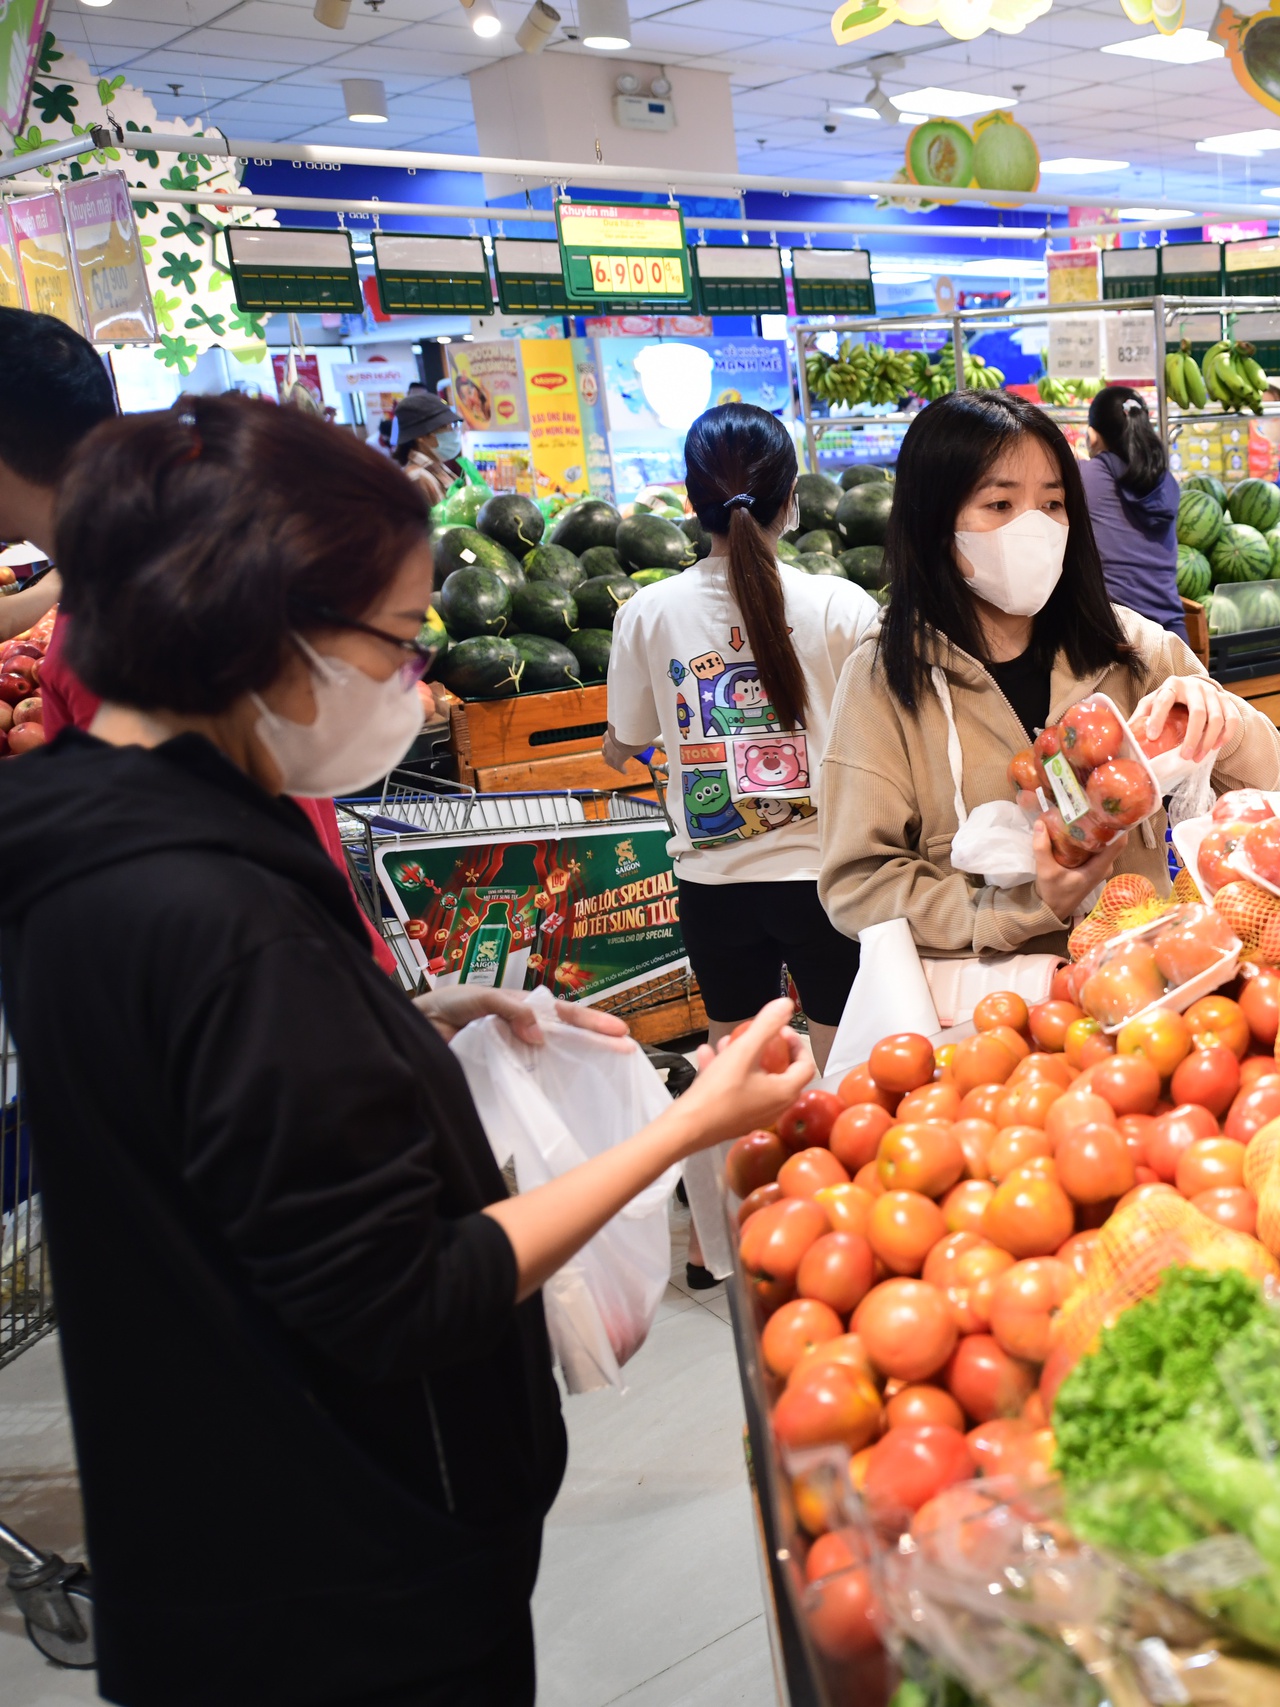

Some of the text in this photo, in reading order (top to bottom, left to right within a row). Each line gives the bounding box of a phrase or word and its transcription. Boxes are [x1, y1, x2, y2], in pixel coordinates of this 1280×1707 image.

[70, 193, 113, 224] Khuyến mãi
[561, 206, 618, 217] Khuyến mãi
[595, 261, 663, 284] 6.900
[695, 656, 721, 672] HI!
[681, 747, 721, 761] STORY
[615, 861, 641, 875] SAIGON
[574, 870, 679, 919] TẶNG LỘC SPECIAL
[588, 911, 610, 936] TẾT
[609, 906, 646, 933] SUNG
[646, 896, 680, 926] TÚC
[626, 934, 636, 943] CHO
[636, 932, 646, 942] DỊP
[645, 928, 674, 940] SPECIAL
[470, 961, 499, 969] SAIGON
[605, 973, 618, 983] TUỔI
[617, 966, 636, 979] KHÔNG
[635, 960, 650, 971] ĐƯỢC
[650, 954, 665, 965] UỐNG
[665, 949, 679, 959] RƯỢU
